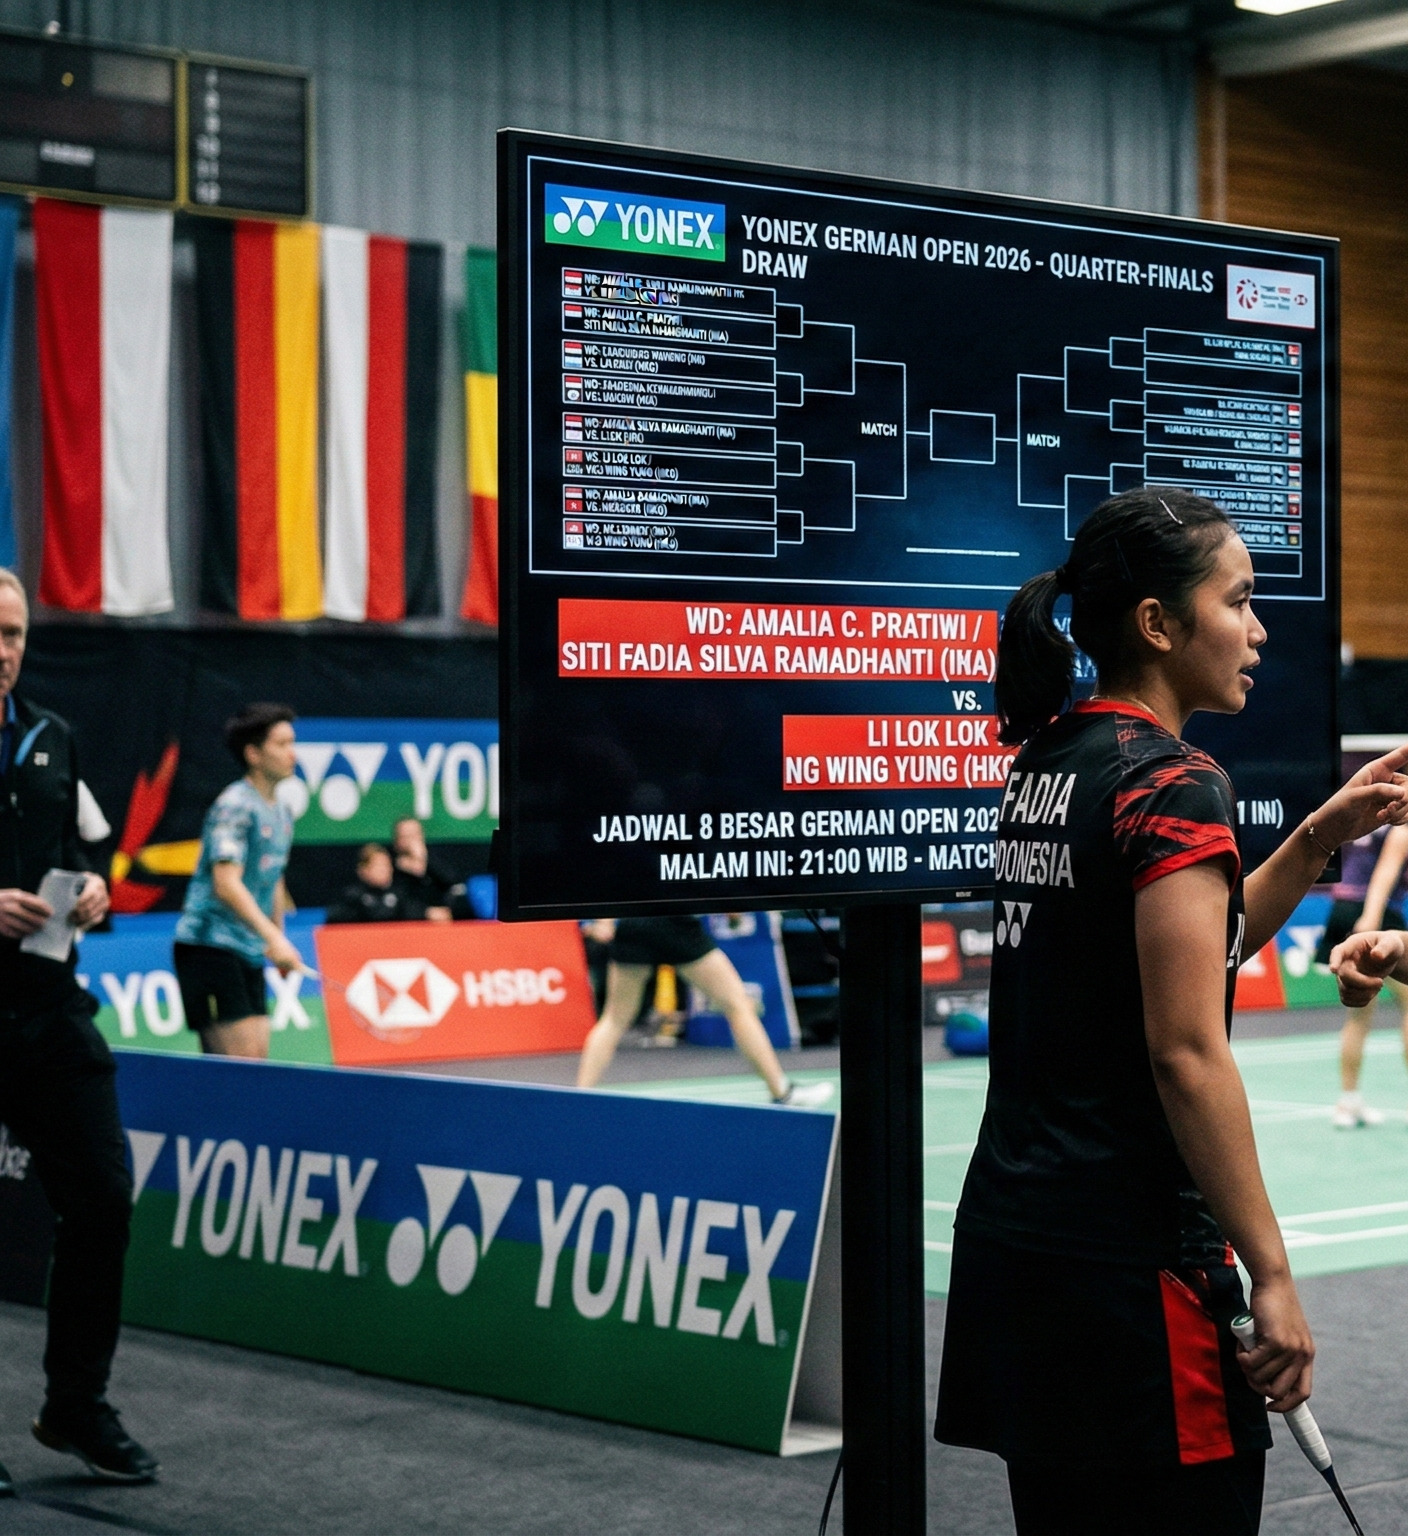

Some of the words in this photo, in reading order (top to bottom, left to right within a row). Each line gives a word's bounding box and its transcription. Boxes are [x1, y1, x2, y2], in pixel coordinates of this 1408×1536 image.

[615, 203, 715, 250] YONEX
[741, 214, 818, 248] YONEX
[824, 225, 917, 259] GERMAN
[923, 236, 979, 266] OPEN
[984, 244, 1032, 272] 2026
[1049, 251, 1214, 294] QUARTER-FINALS
[742, 248, 808, 280] DRAW
[861, 421, 898, 437] MATCH
[1026, 432, 1060, 448] MATCH
[685, 606, 732, 635] WD:
[739, 608, 835, 637] AMALIA
[841, 610, 864, 638] C.
[871, 611, 966, 641] PRATIWI
[972, 614, 983, 643] /
[561, 641, 611, 671] SITI
[619, 642, 693, 671] FADIA
[699, 644, 768, 673] SILVA
[775, 646, 934, 675] RAMADHANTI
[952, 690, 982, 711] VS.
[867, 719, 888, 747] LI
[895, 719, 940, 747] LOK
[945, 719, 989, 747] LOK
[400, 741, 498, 820] YO
[785, 756, 820, 784] NG
[825, 755, 889, 784] WING
[894, 755, 957, 783] YUNG
[1000, 771, 1077, 826] FADIA
[593, 813, 693, 843] JADWAL
[700, 813, 713, 840] 8
[720, 811, 795, 840] BESAR
[801, 809, 895, 837] GERMAN
[901, 807, 958, 835] OPEN
[964, 807, 999, 833] 202
[660, 851, 749, 881] MALAM
[756, 850, 794, 877] INI:
[800, 848, 861, 876] 21:00
[866, 846, 908, 873] WIB
[995, 839, 1075, 889] DONESIA
[102, 968, 312, 1038] YOX
[462, 967, 566, 1008] HSBC
[171, 1135, 379, 1277] YONEX
[534, 1178, 796, 1347] YONEX
